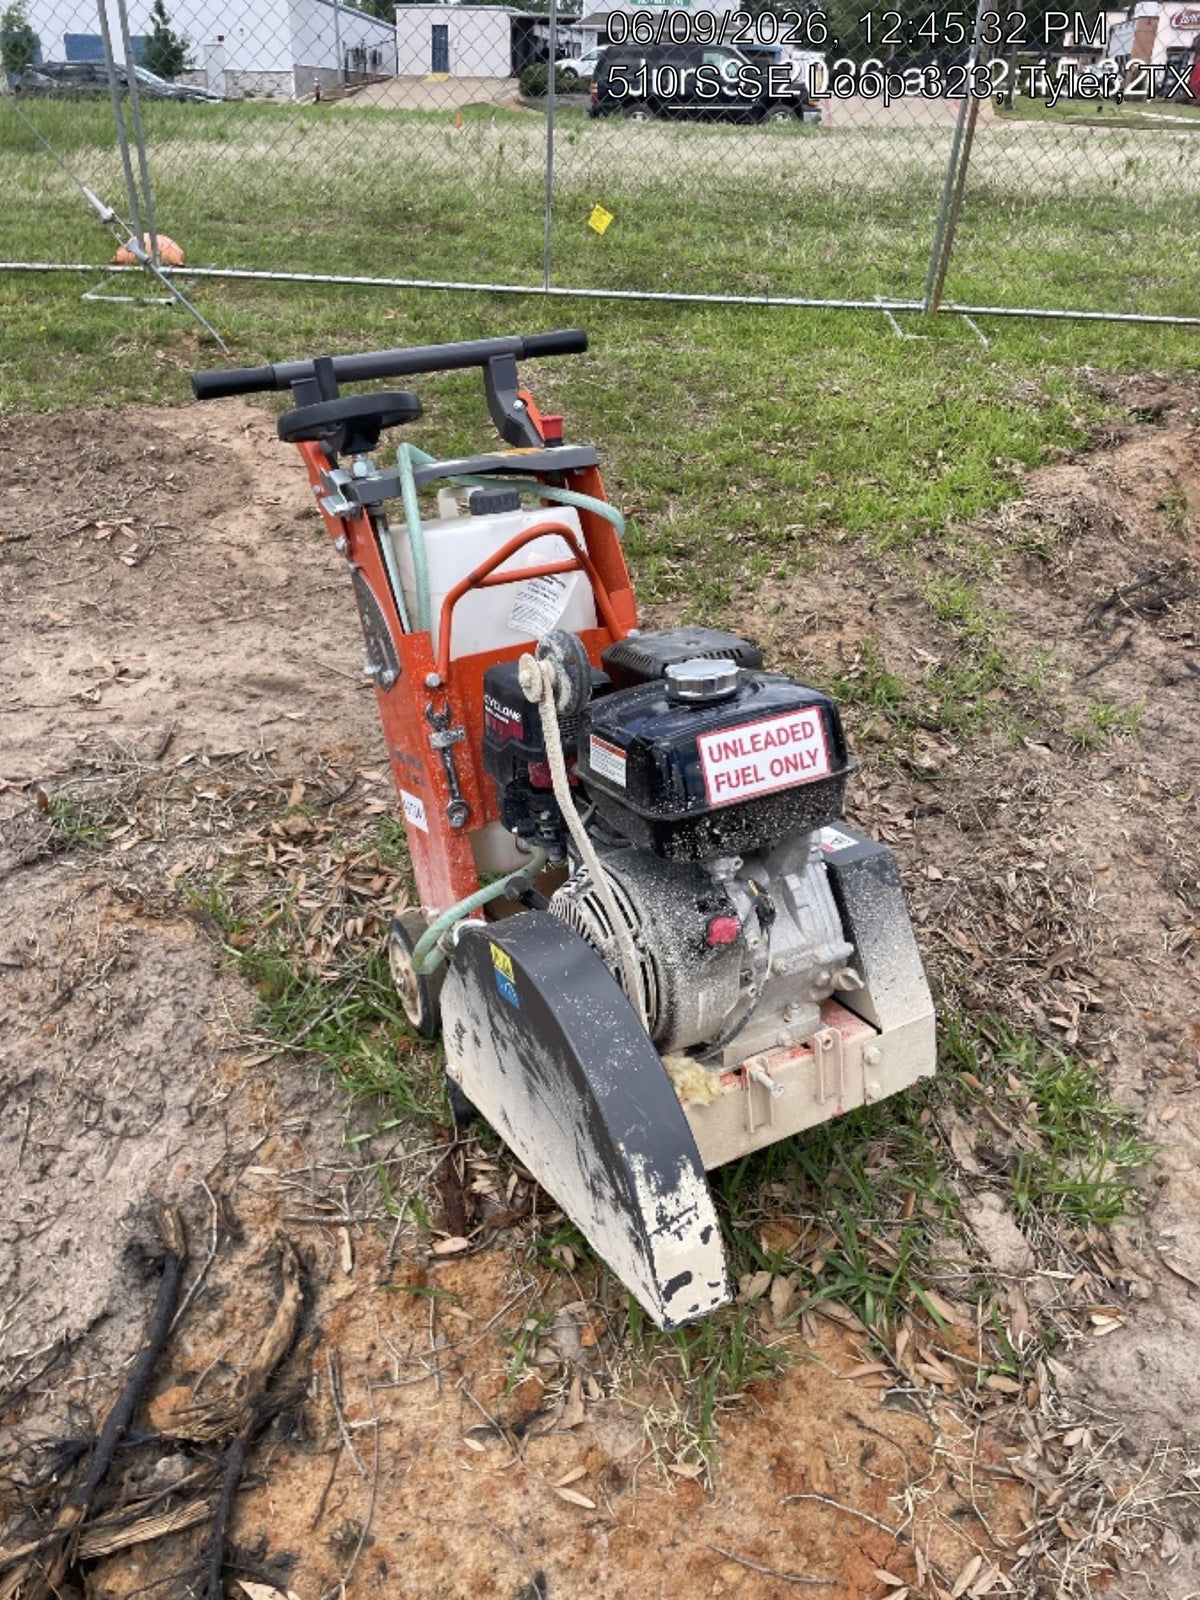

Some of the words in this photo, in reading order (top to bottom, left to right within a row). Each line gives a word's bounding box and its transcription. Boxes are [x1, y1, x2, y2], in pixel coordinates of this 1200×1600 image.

[707, 720, 816, 763] UNLEADED
[713, 763, 766, 793] FUEL
[769, 747, 819, 778] ONLY
